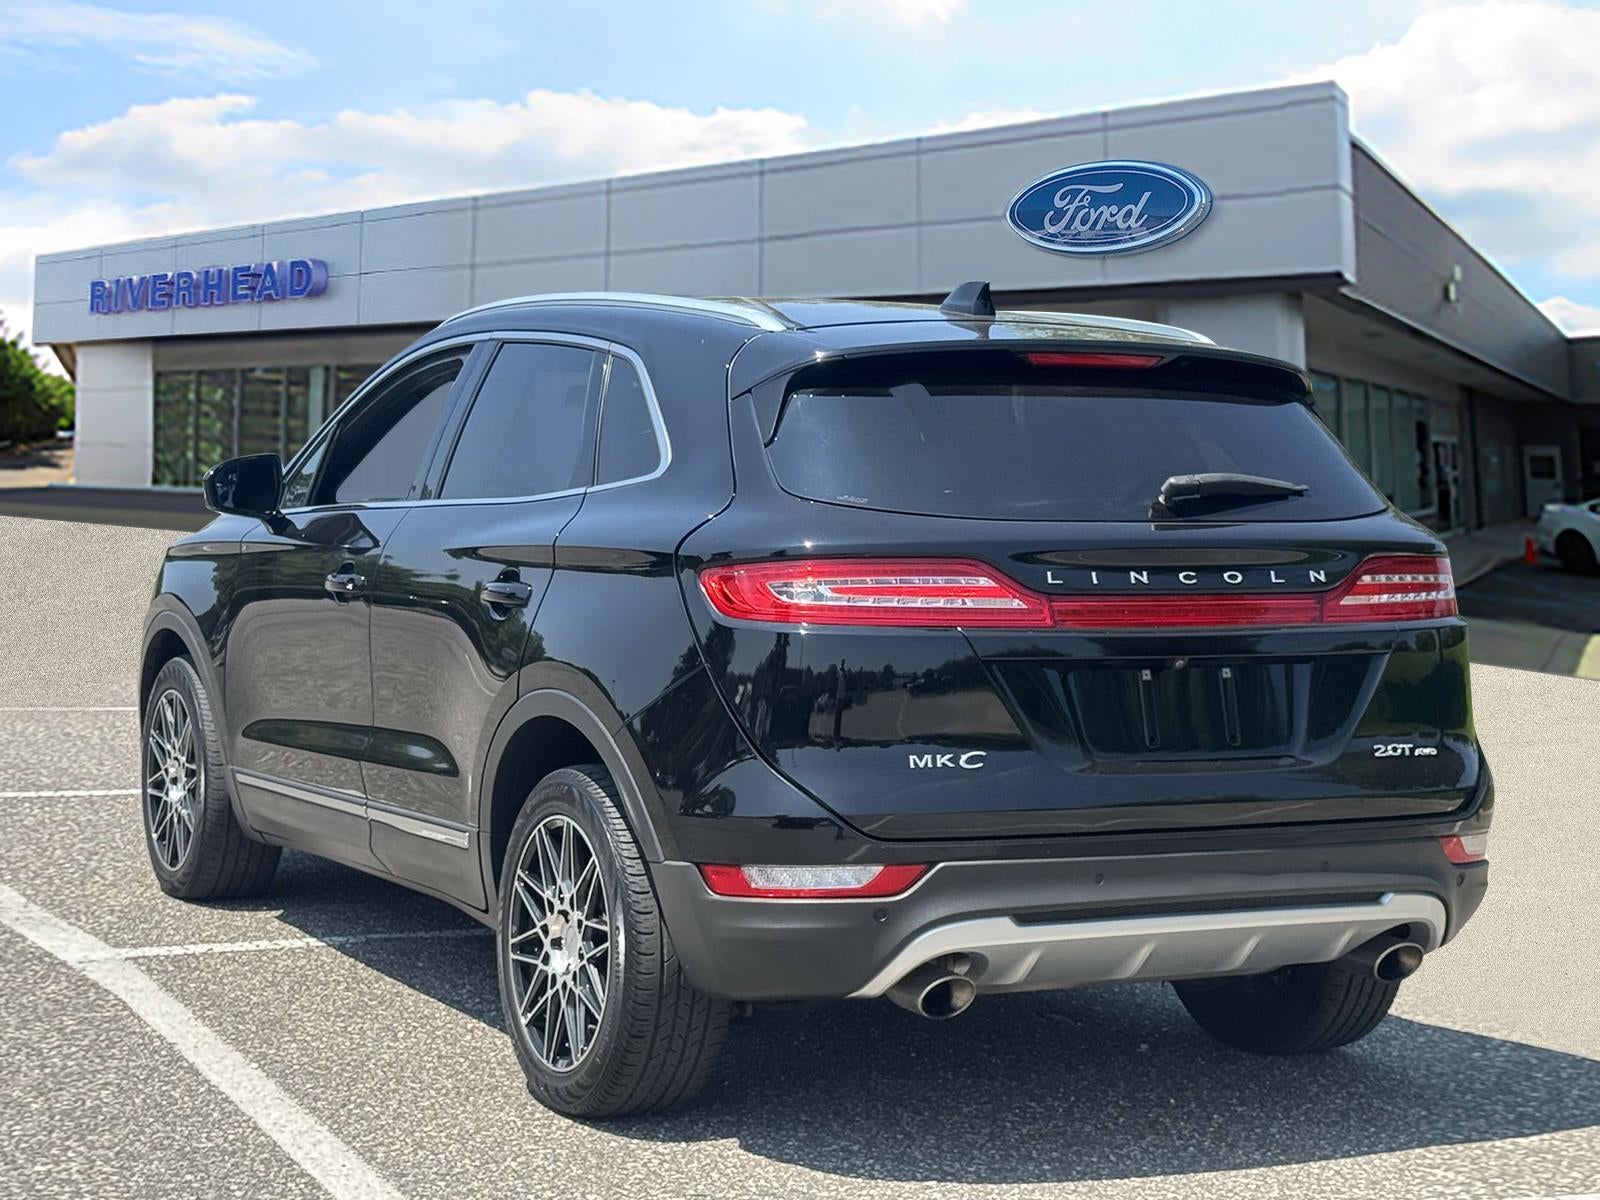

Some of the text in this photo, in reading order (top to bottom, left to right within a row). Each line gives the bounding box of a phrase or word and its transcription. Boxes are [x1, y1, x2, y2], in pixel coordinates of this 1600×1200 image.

[1043, 182, 1152, 234] Ford
[89, 259, 326, 315] RIVERHEAD
[1046, 570, 1327, 584] LINCOLN
[908, 750, 987, 769] MKC
